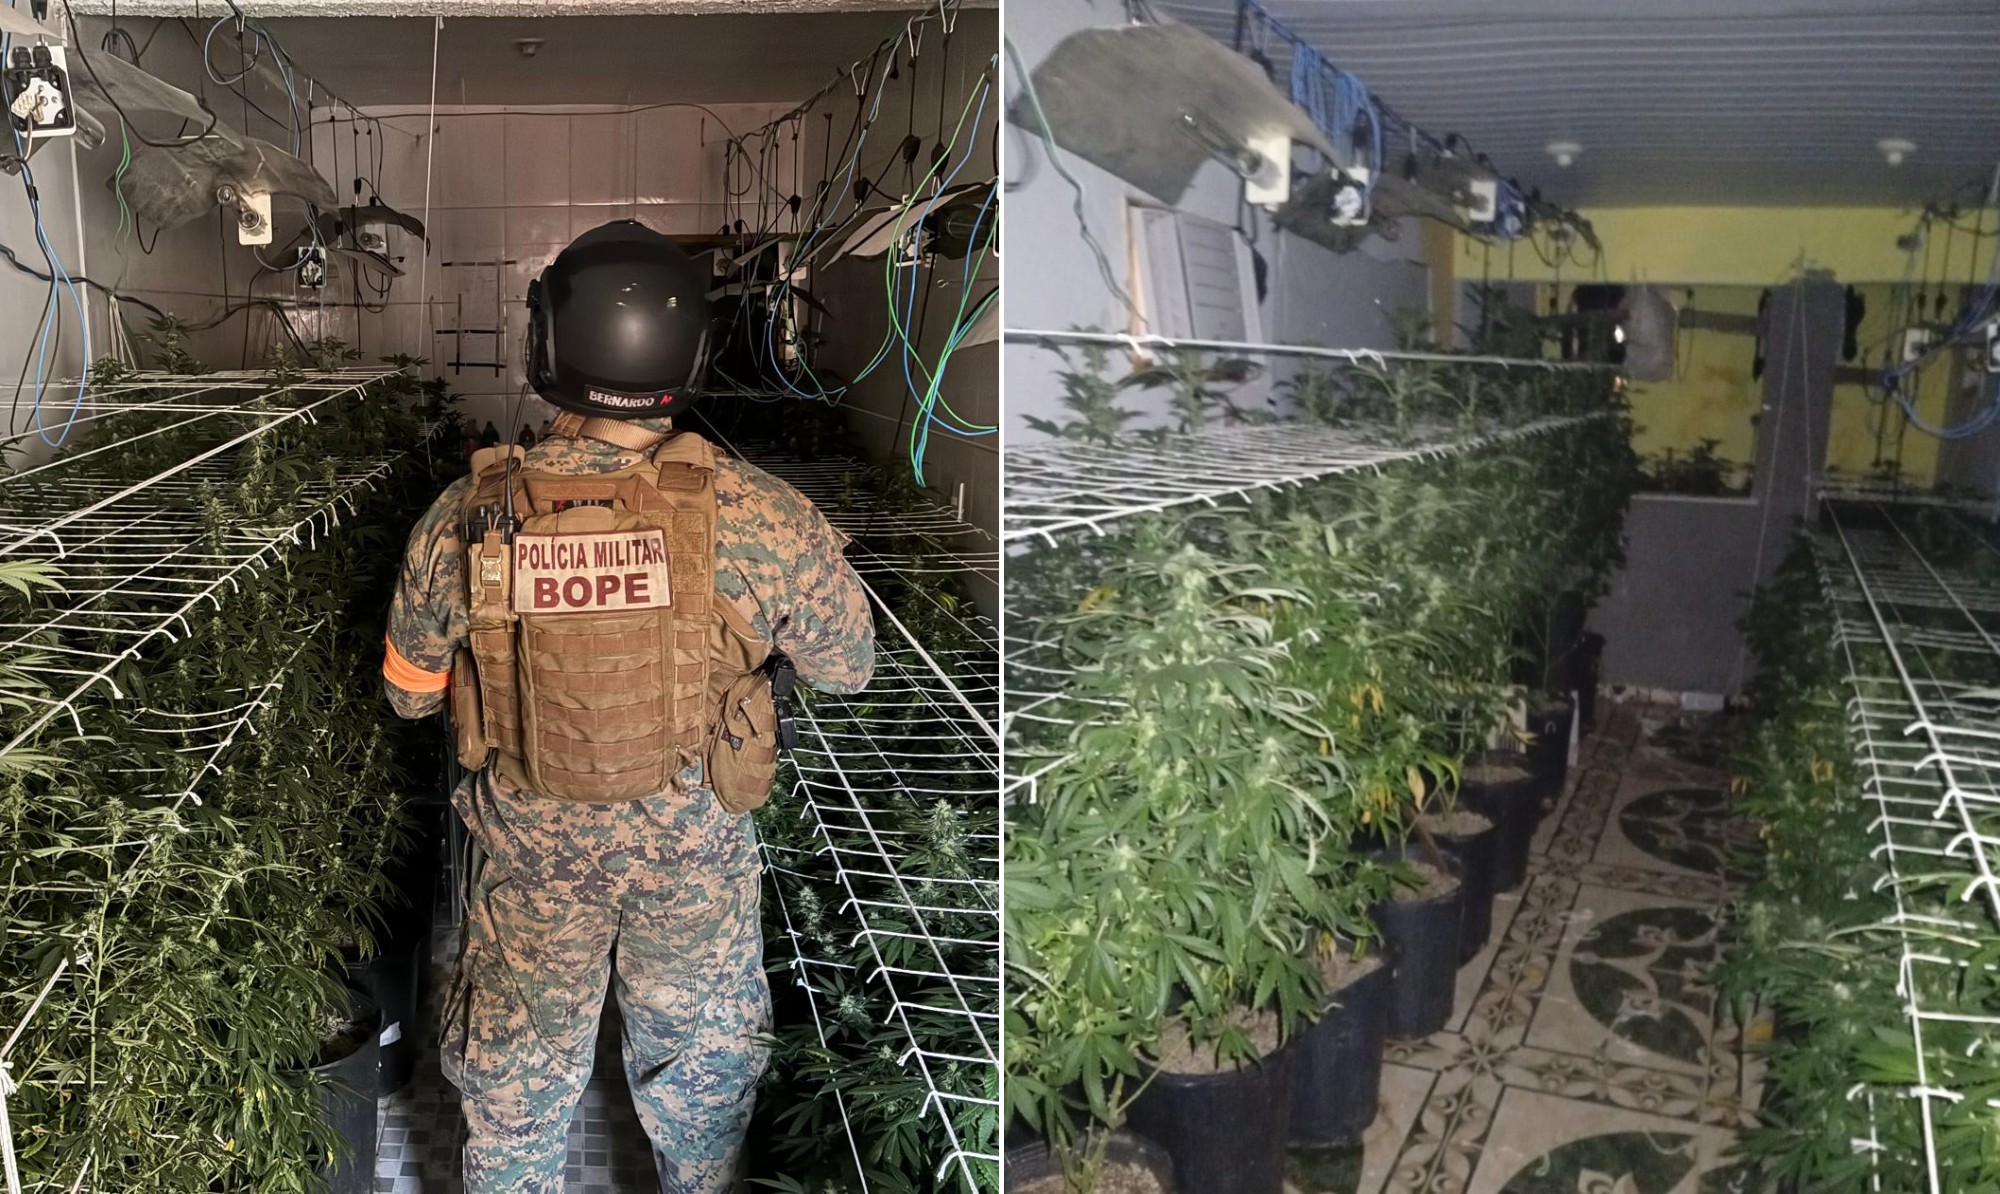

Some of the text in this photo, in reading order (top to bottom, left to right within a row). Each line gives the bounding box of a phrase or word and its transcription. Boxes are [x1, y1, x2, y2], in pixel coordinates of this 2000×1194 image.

[589, 390, 655, 408] BERNARDO
[594, 538, 665, 569] MILITAR
[533, 572, 651, 609] BOPE
